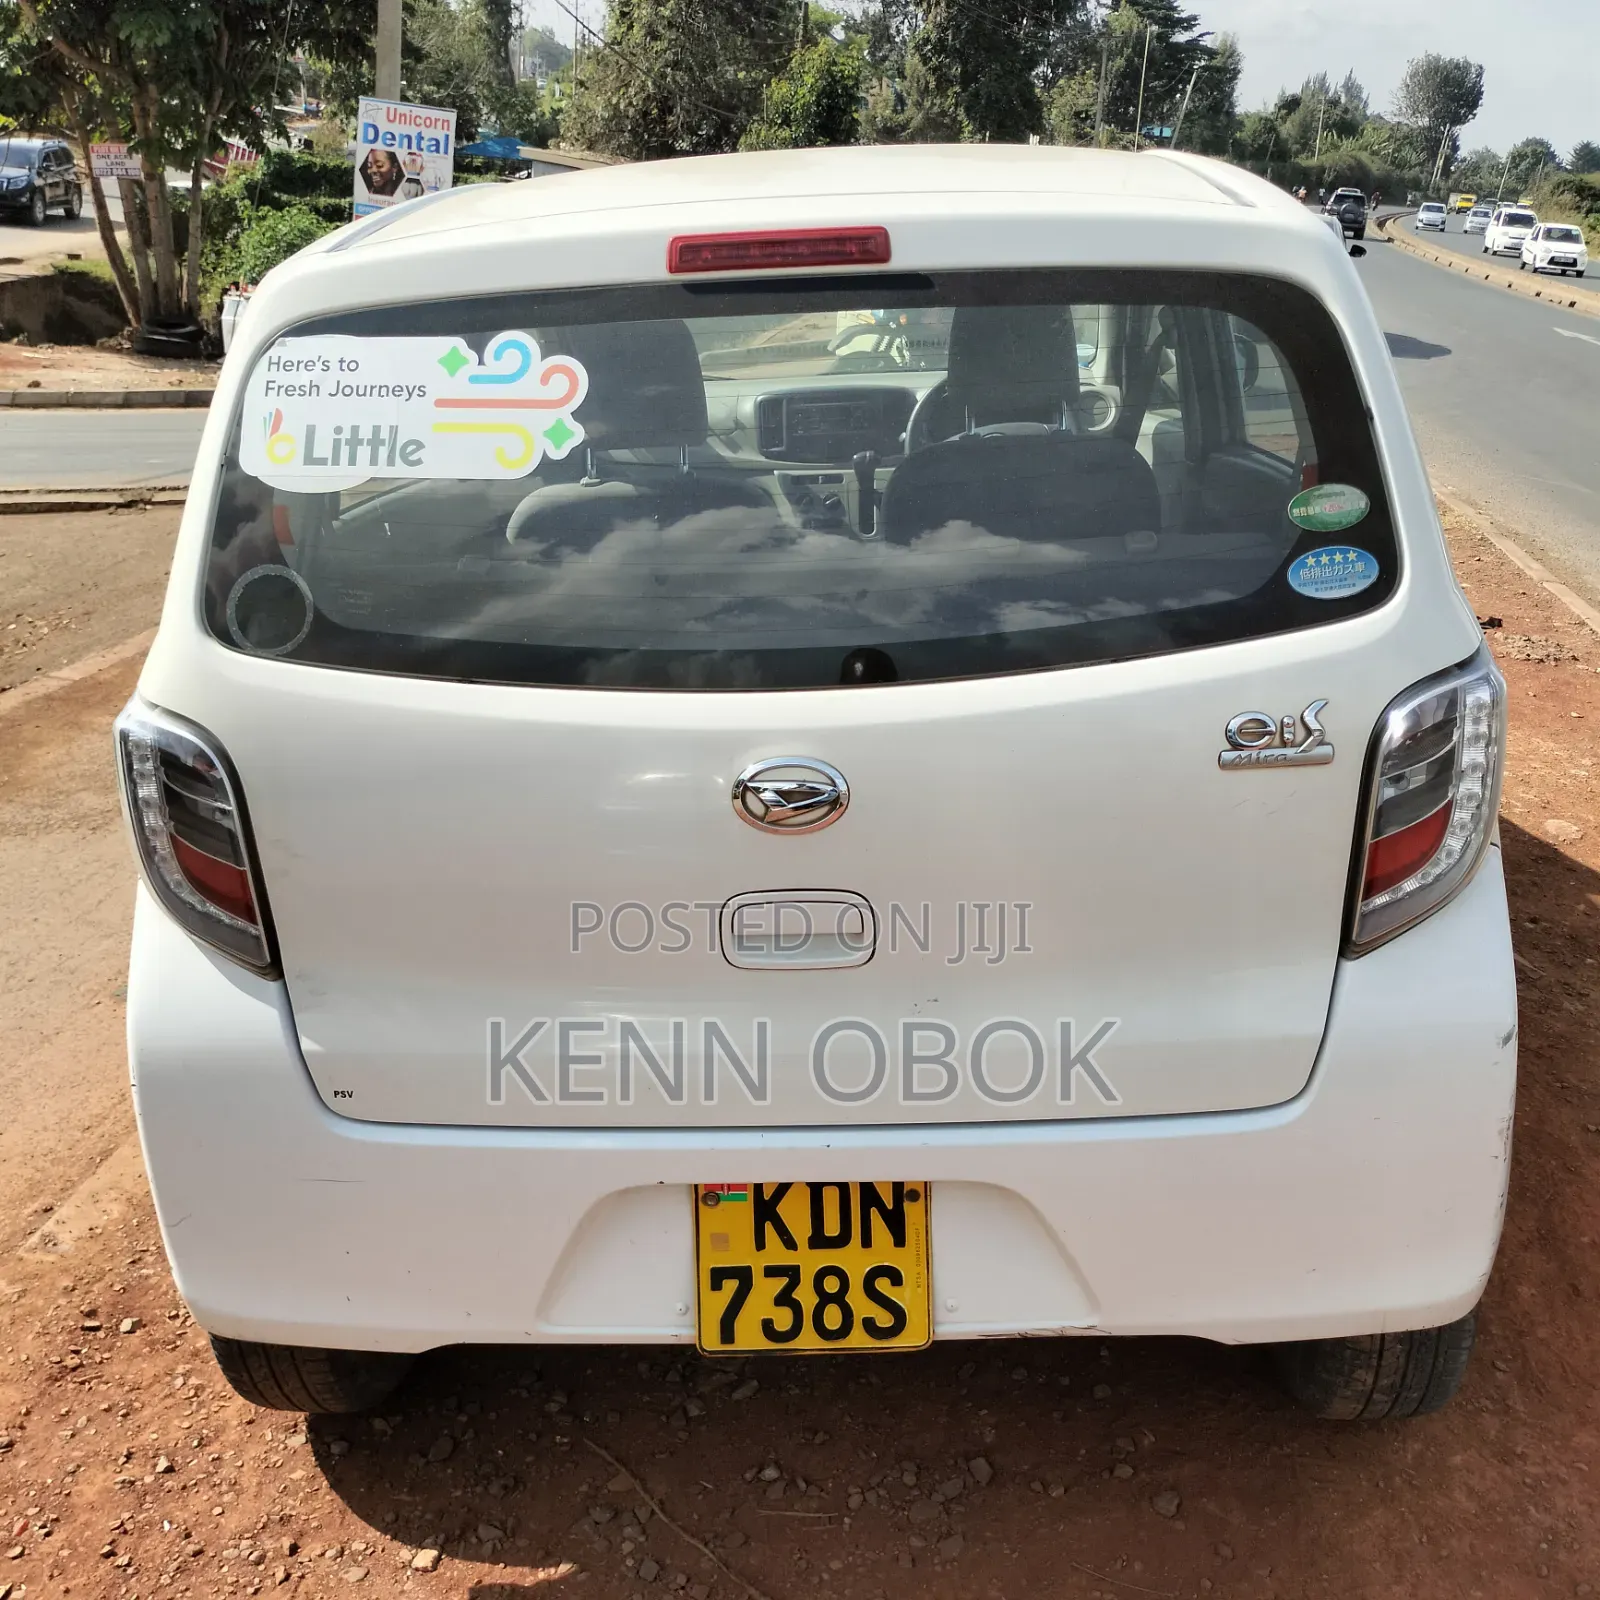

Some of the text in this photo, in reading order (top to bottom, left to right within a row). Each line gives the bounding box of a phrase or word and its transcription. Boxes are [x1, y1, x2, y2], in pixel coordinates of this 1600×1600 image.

[386, 106, 451, 132] Unicorn
[362, 122, 450, 156] Dental
[267, 355, 360, 372] Here's to
[264, 380, 427, 402] Fresh Journeys
[303, 424, 426, 467] Little
[1300, 561, 1366, 581] 低排出ガス車
[333, 1090, 354, 1099] PSV
[753, 1181, 907, 1252] KDN
[710, 1263, 908, 1345] 738S
